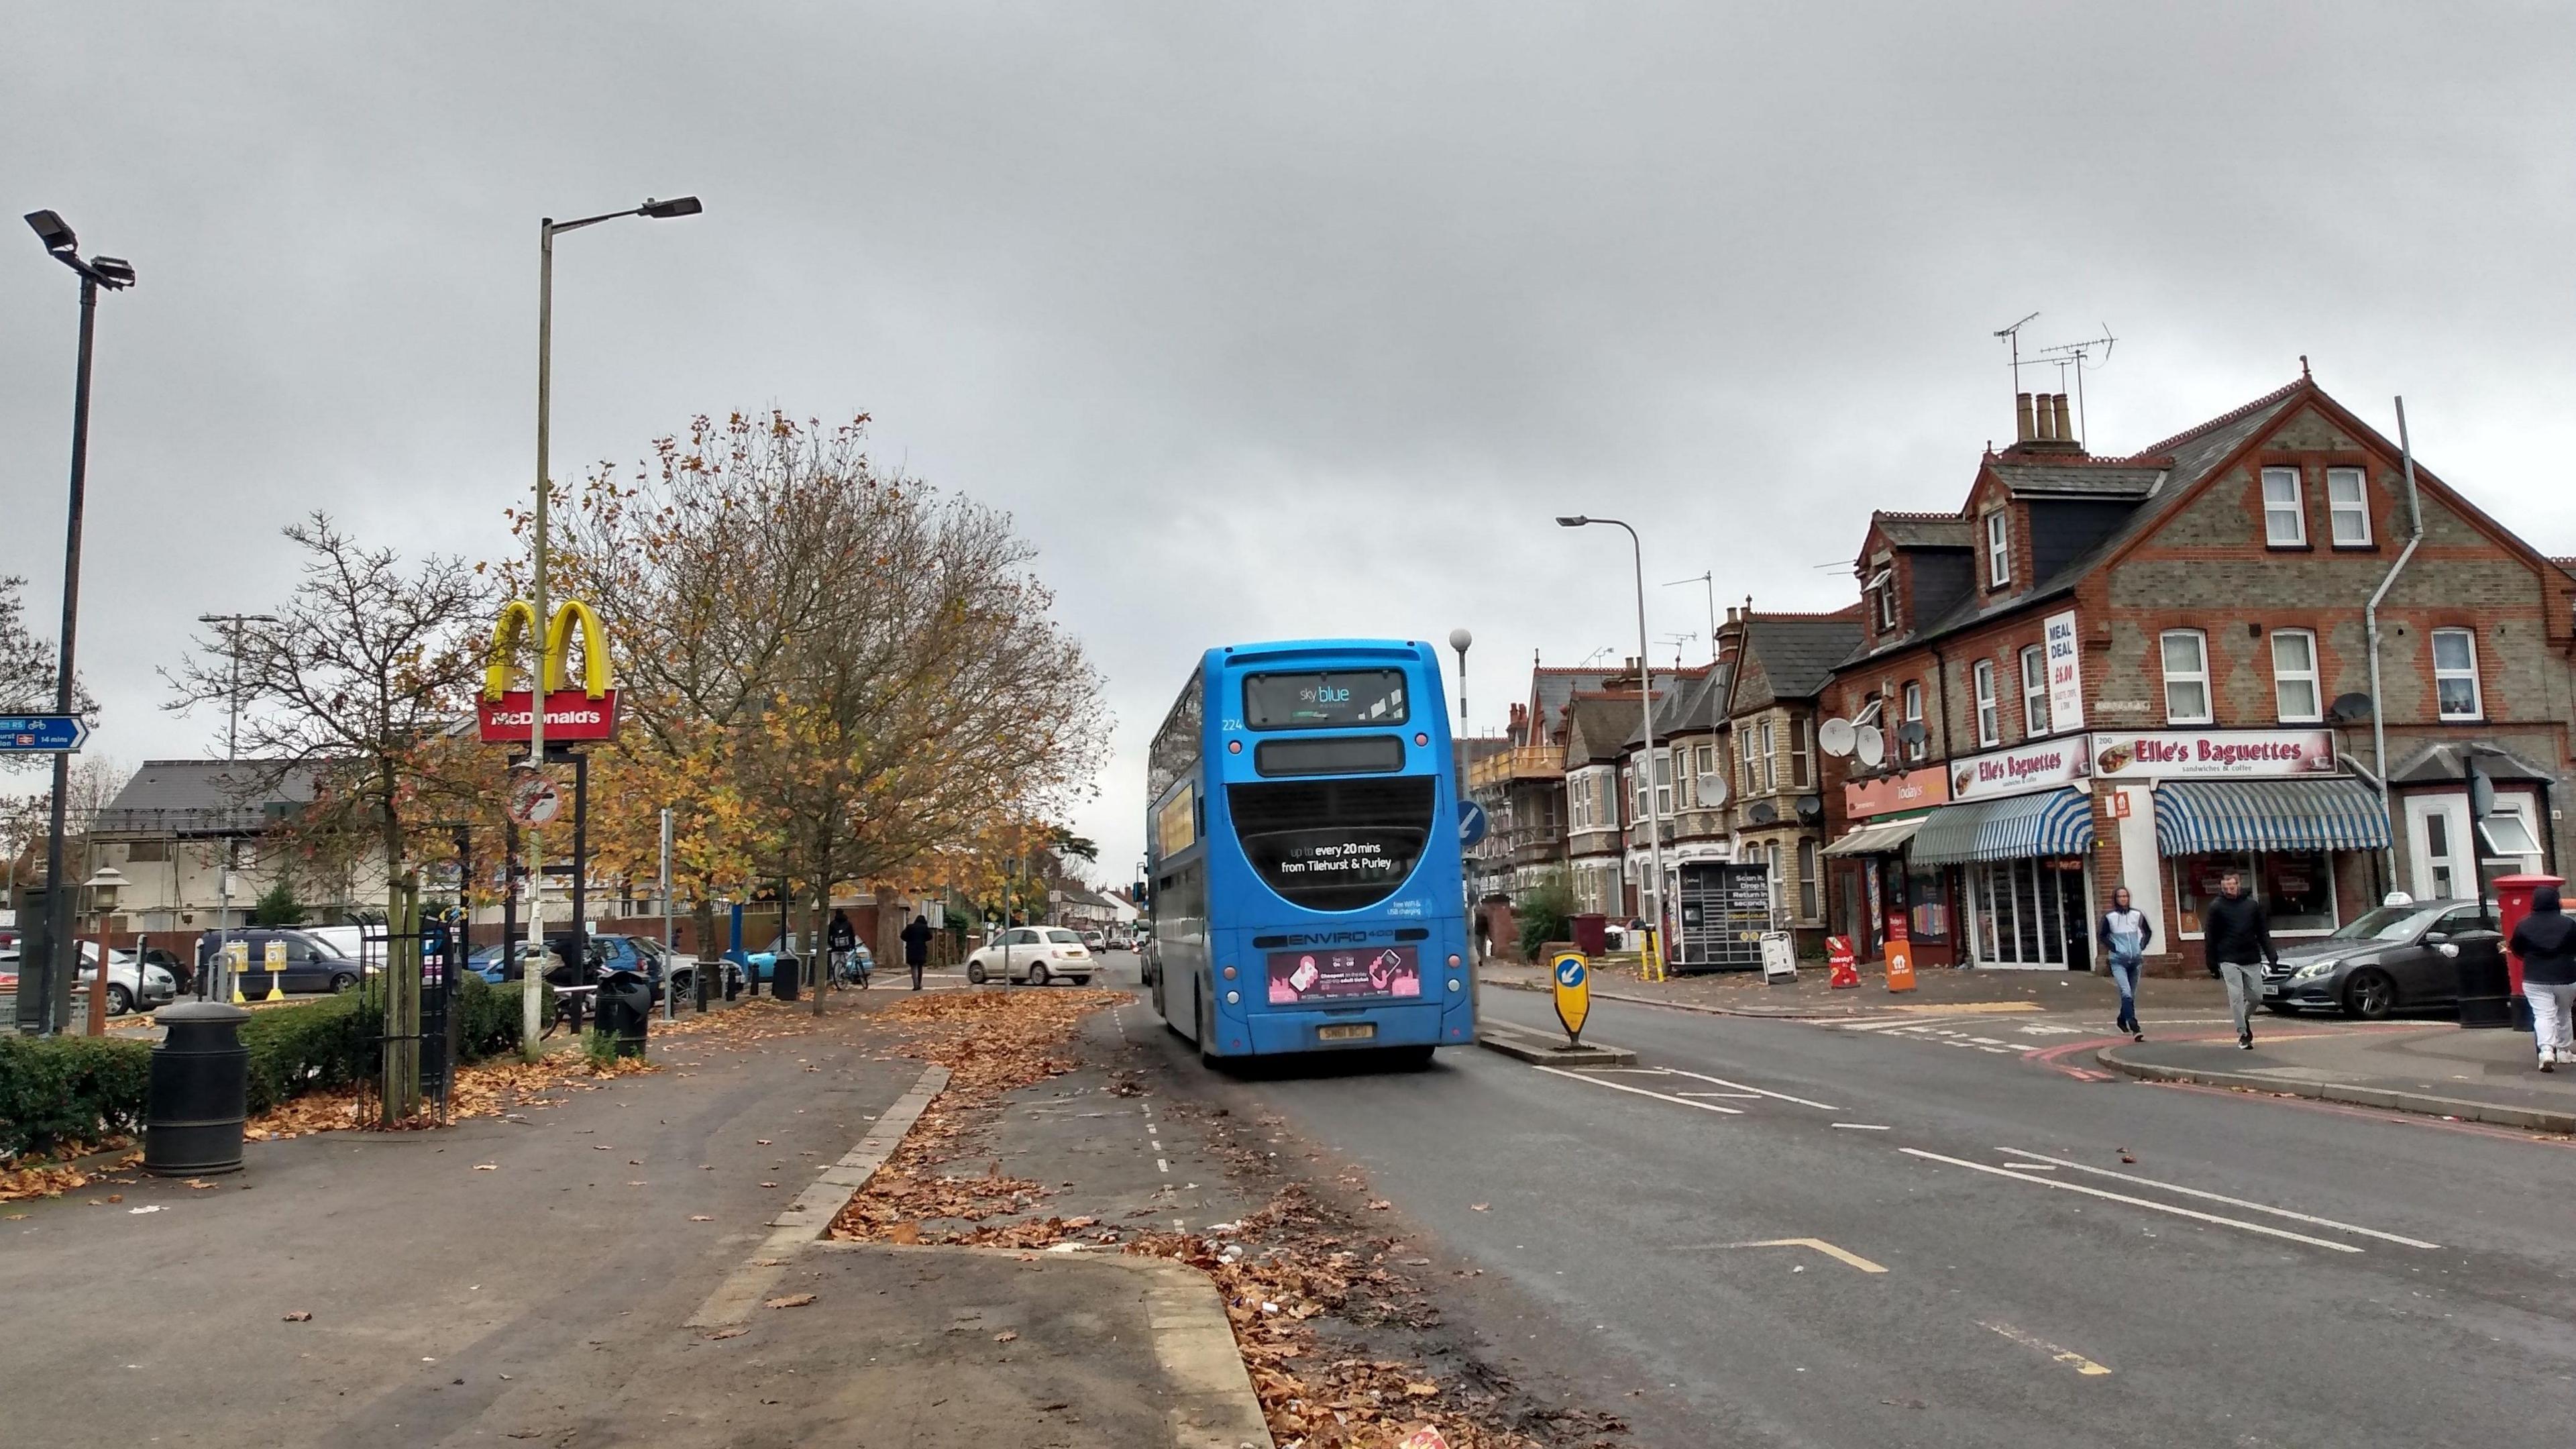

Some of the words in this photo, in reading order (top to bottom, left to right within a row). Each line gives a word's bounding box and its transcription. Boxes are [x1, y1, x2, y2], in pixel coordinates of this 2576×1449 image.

[2049, 623, 2071, 641] MEAL
[2051, 641, 2072, 659] DEAL
[2055, 664, 2072, 685] £6.00
[1300, 688, 1317, 702] sky
[1319, 686, 1350, 702] blue
[491, 710, 600, 725] McDnald's
[1222, 719, 1242, 731] 224
[2135, 740, 2189, 763] Elle's
[2197, 739, 2302, 765] Baguettes
[1979, 761, 2004, 782] Elle's
[2008, 752, 2061, 778] Baguettes
[1315, 846, 1342, 857] every
[1343, 843, 1357, 854] 20
[1358, 843, 1381, 853] mins
[1282, 862, 1305, 873] from
[1307, 859, 1348, 871] Tilehurst
[1351, 859, 1360, 869] &
[1362, 857, 1391, 870] Purley
[1289, 930, 1366, 945] ENVIRO
[1368, 929, 1393, 937] 400
